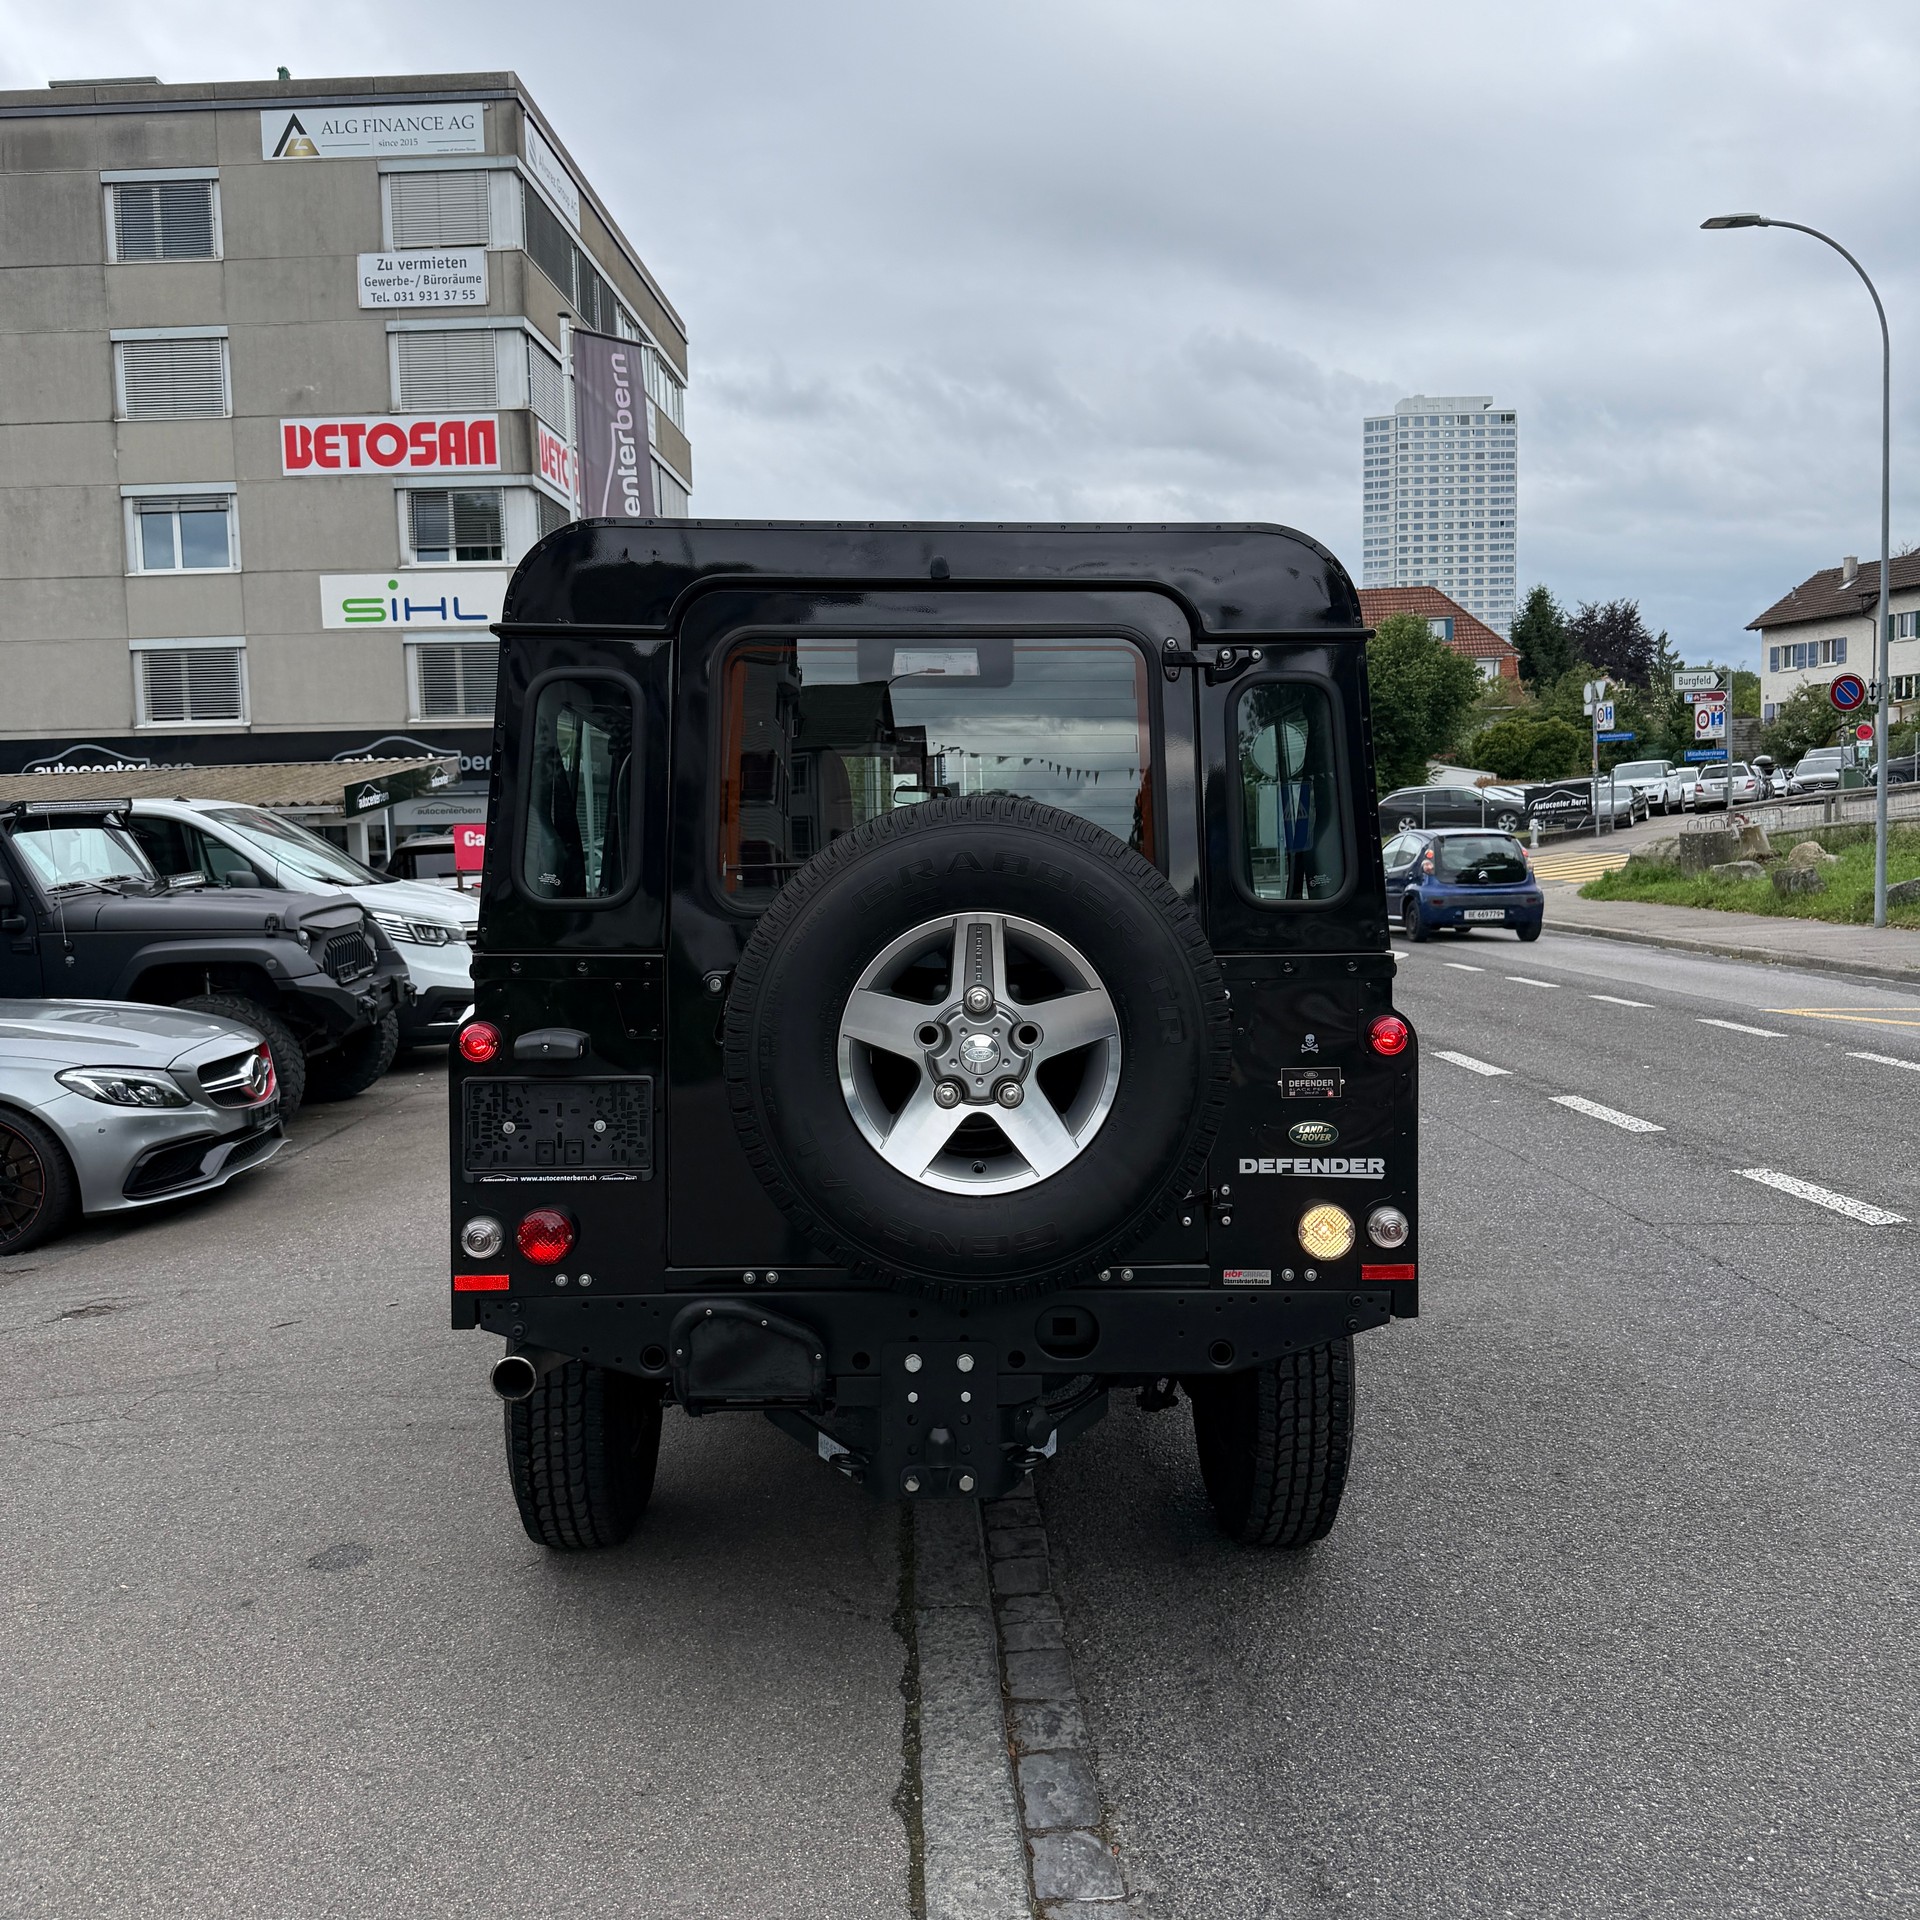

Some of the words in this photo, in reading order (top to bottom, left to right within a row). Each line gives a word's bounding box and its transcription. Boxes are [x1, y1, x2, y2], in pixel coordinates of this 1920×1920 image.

[322, 120, 358, 135] ALG
[363, 116, 444, 133] FINANCE
[448, 114, 475, 130] AG
[378, 139, 399, 147] since
[400, 138, 419, 147] 2015
[377, 259, 393, 271] Zu
[398, 256, 467, 270] vermieten
[371, 292, 390, 303] Tel.
[394, 291, 415, 302] 031
[419, 290, 440, 301] 931
[444, 290, 457, 300] 37
[462, 289, 476, 300] 55
[284, 420, 497, 469] BETOSAN
[1679, 675, 1711, 687] Burgfeld
[1533, 800, 1571, 810] Autocenter
[975, 925, 983, 983] DEFENDER
[1288, 1079, 1334, 1087] DEFENDER
[1301, 1133, 1332, 1141] ROVER
[1239, 1158, 1386, 1174] DEFENDER
